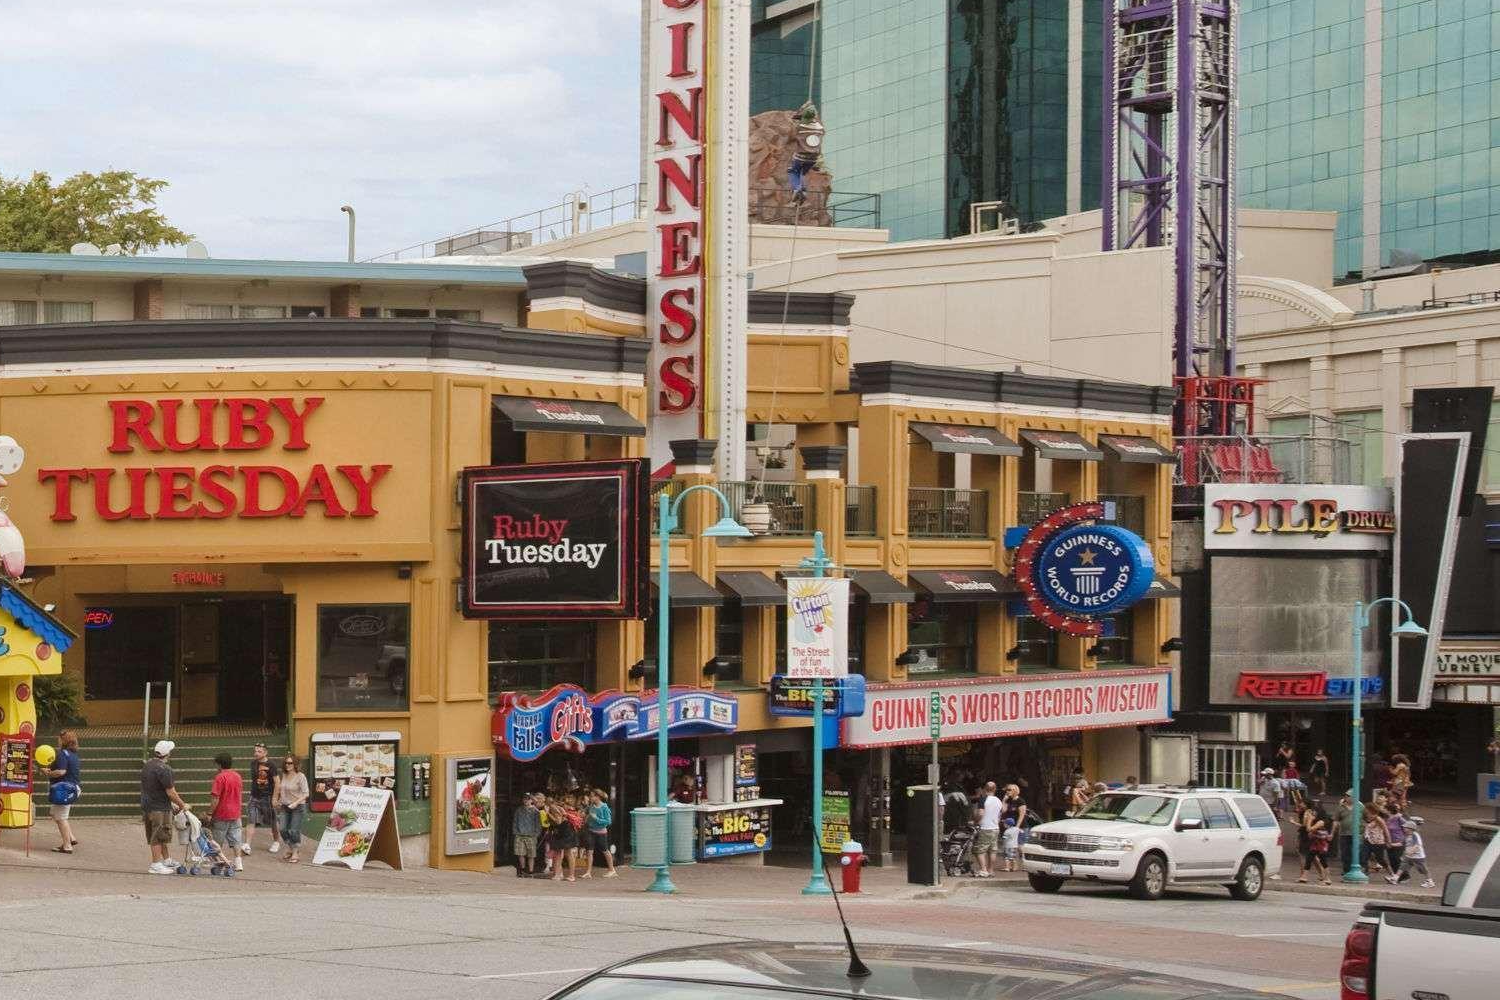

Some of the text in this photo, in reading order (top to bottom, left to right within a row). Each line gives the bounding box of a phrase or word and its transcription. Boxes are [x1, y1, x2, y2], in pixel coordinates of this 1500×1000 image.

[107, 396, 325, 453] RUBY
[38, 463, 393, 523] TUESDAY
[493, 514, 569, 545] Ruby
[1212, 499, 1339, 535] PILE
[484, 537, 607, 570] Tuesday
[1054, 533, 1123, 559] GUINNESS
[171, 571, 226, 585] ENTRANCE
[1046, 564, 1131, 608] WORLD RECORDS
[792, 647, 830, 657] The Street
[800, 657, 821, 667] of fun
[1457, 655, 1500, 664] MOVIE
[792, 667, 831, 676] at the Falls
[512, 711, 543, 728] NIAGARA
[551, 693, 593, 742] Gifts
[872, 682, 1160, 732] GUINNSS WORLD RECORDS MUSEUM
[513, 725, 544, 752] Falls
[712, 826, 723, 835] The
[723, 815, 750, 834] BIG
